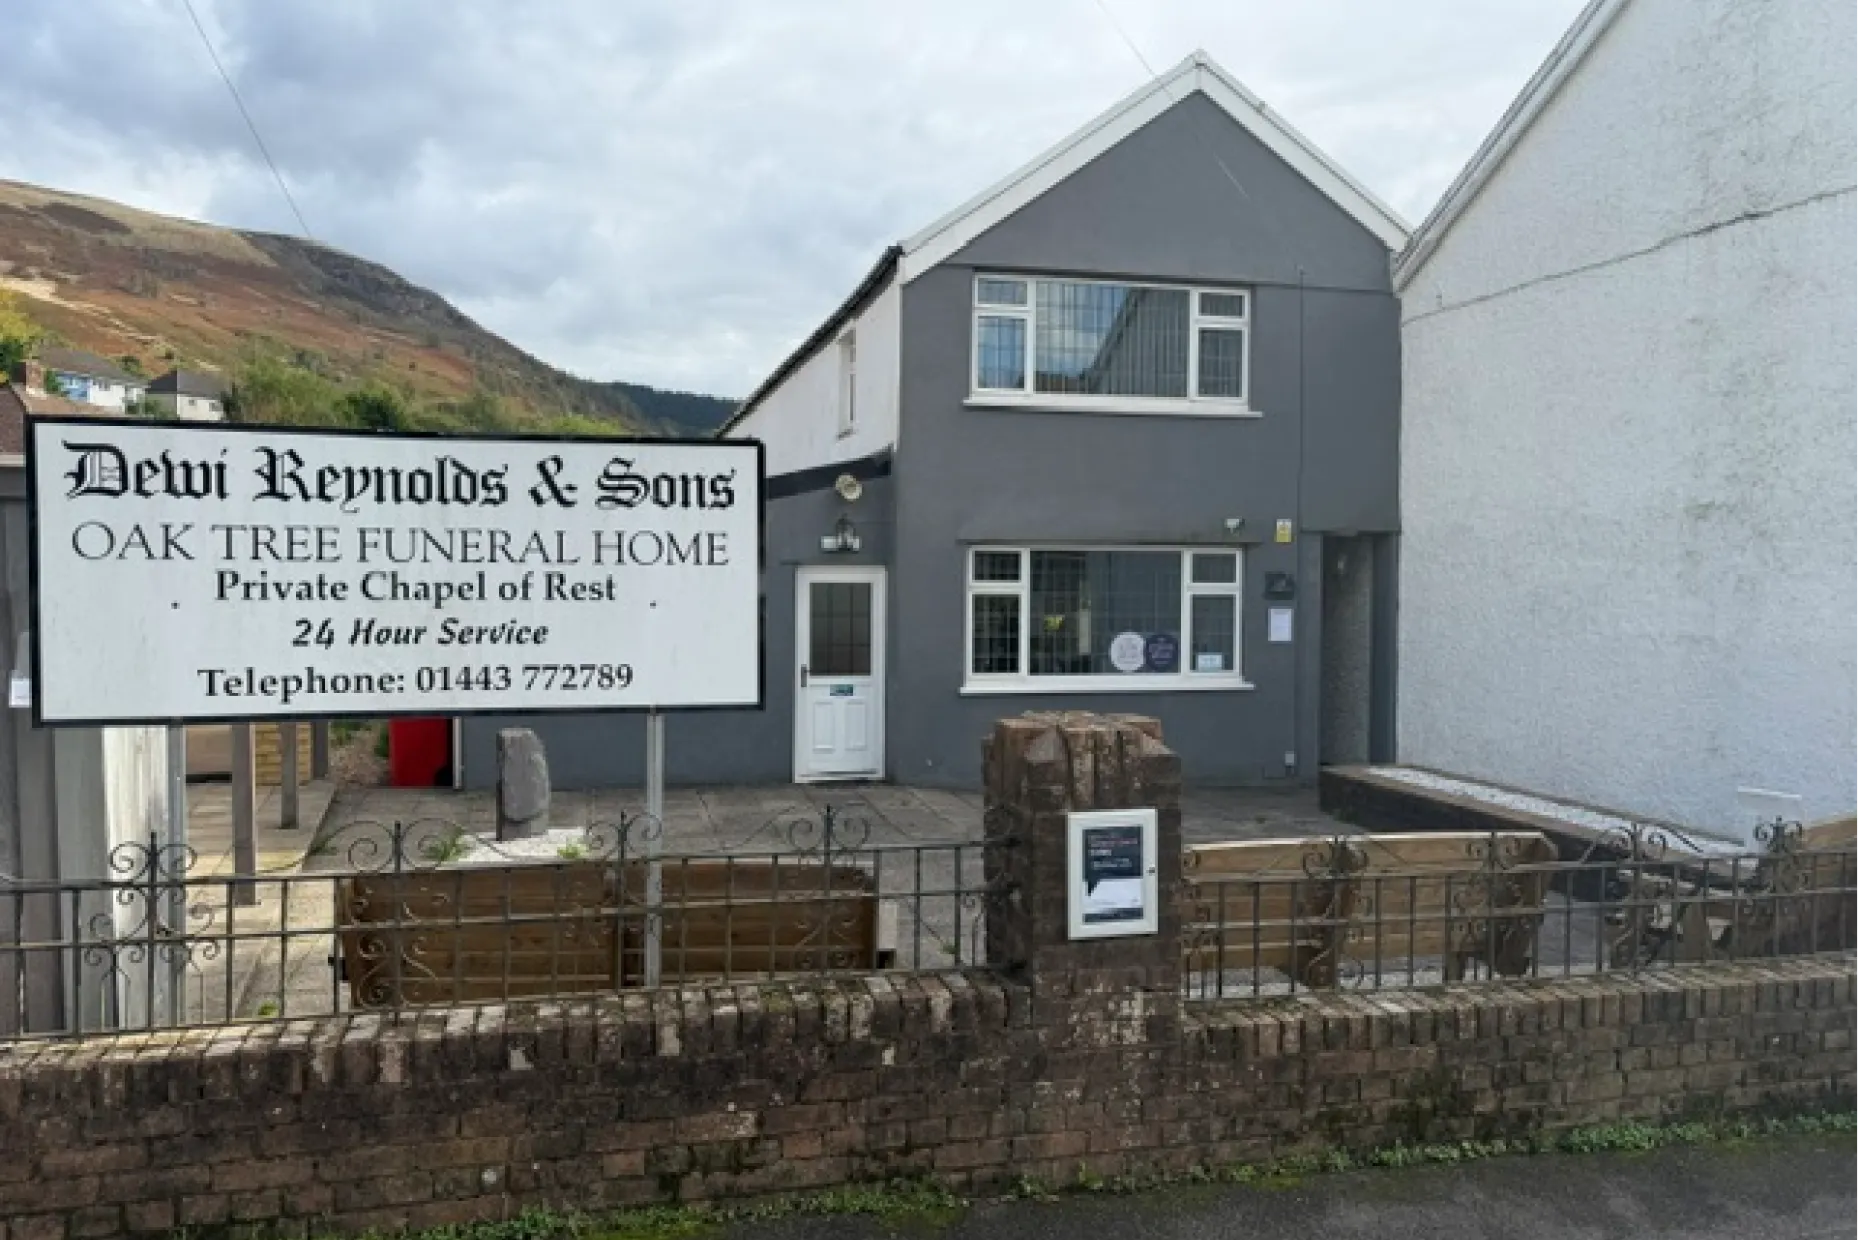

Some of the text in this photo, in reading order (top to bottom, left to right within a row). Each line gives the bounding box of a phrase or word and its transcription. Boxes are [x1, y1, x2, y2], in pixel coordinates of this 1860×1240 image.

[61, 439, 737, 514] Dewi Reynolds & Sons
[71, 521, 729, 566] OAK TREE FUNERAL HOME
[216, 570, 616, 610] Private Chapel of Rest
[292, 616, 549, 650] 24 Hour Service
[196, 663, 634, 705] Telephone: 01443 772789
